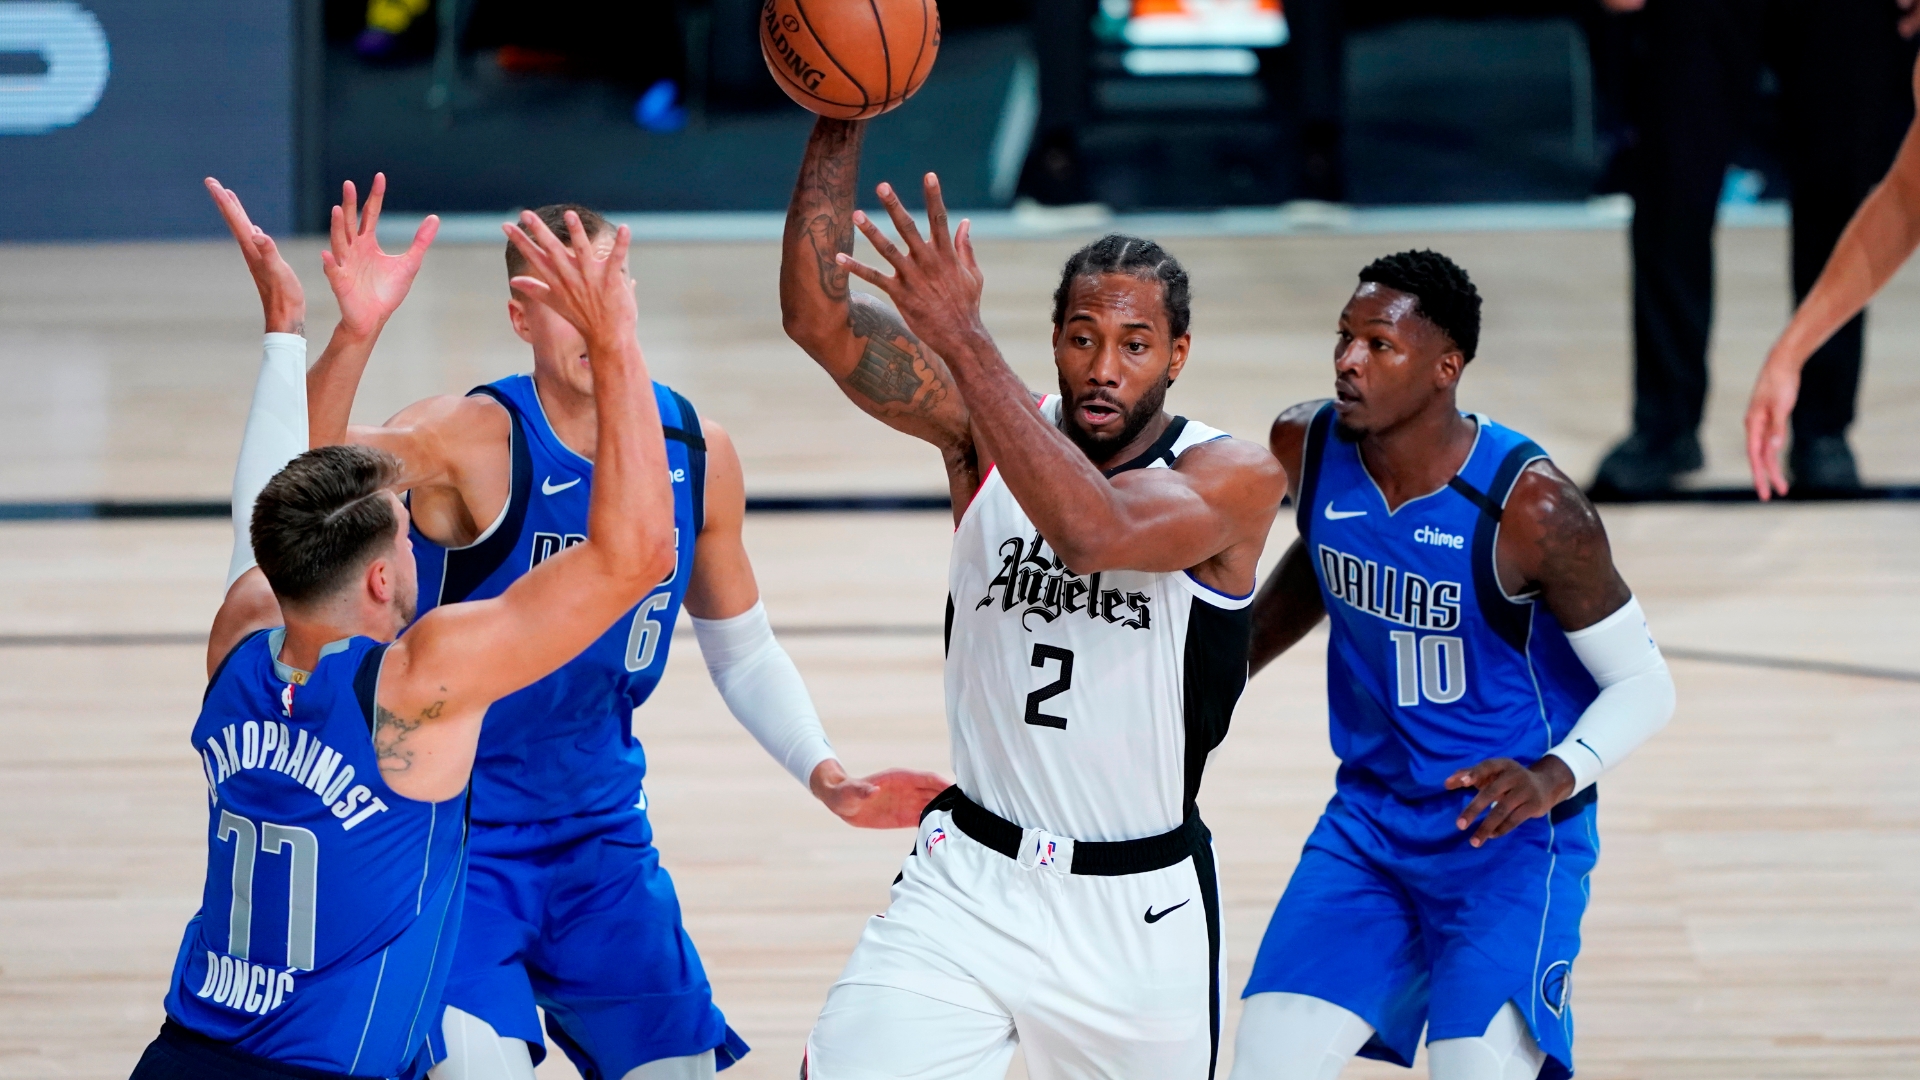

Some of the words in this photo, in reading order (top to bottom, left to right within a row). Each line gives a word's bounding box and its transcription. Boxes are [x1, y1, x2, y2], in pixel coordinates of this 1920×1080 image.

[764, 0, 826, 92] PALDING
[1414, 525, 1465, 550] chime
[975, 536, 1152, 633] Angeles
[1318, 544, 1462, 632] DALLAS
[624, 592, 672, 673] 6
[1389, 630, 1467, 707] 10
[1024, 643, 1075, 730] 2
[217, 809, 319, 972] 77
